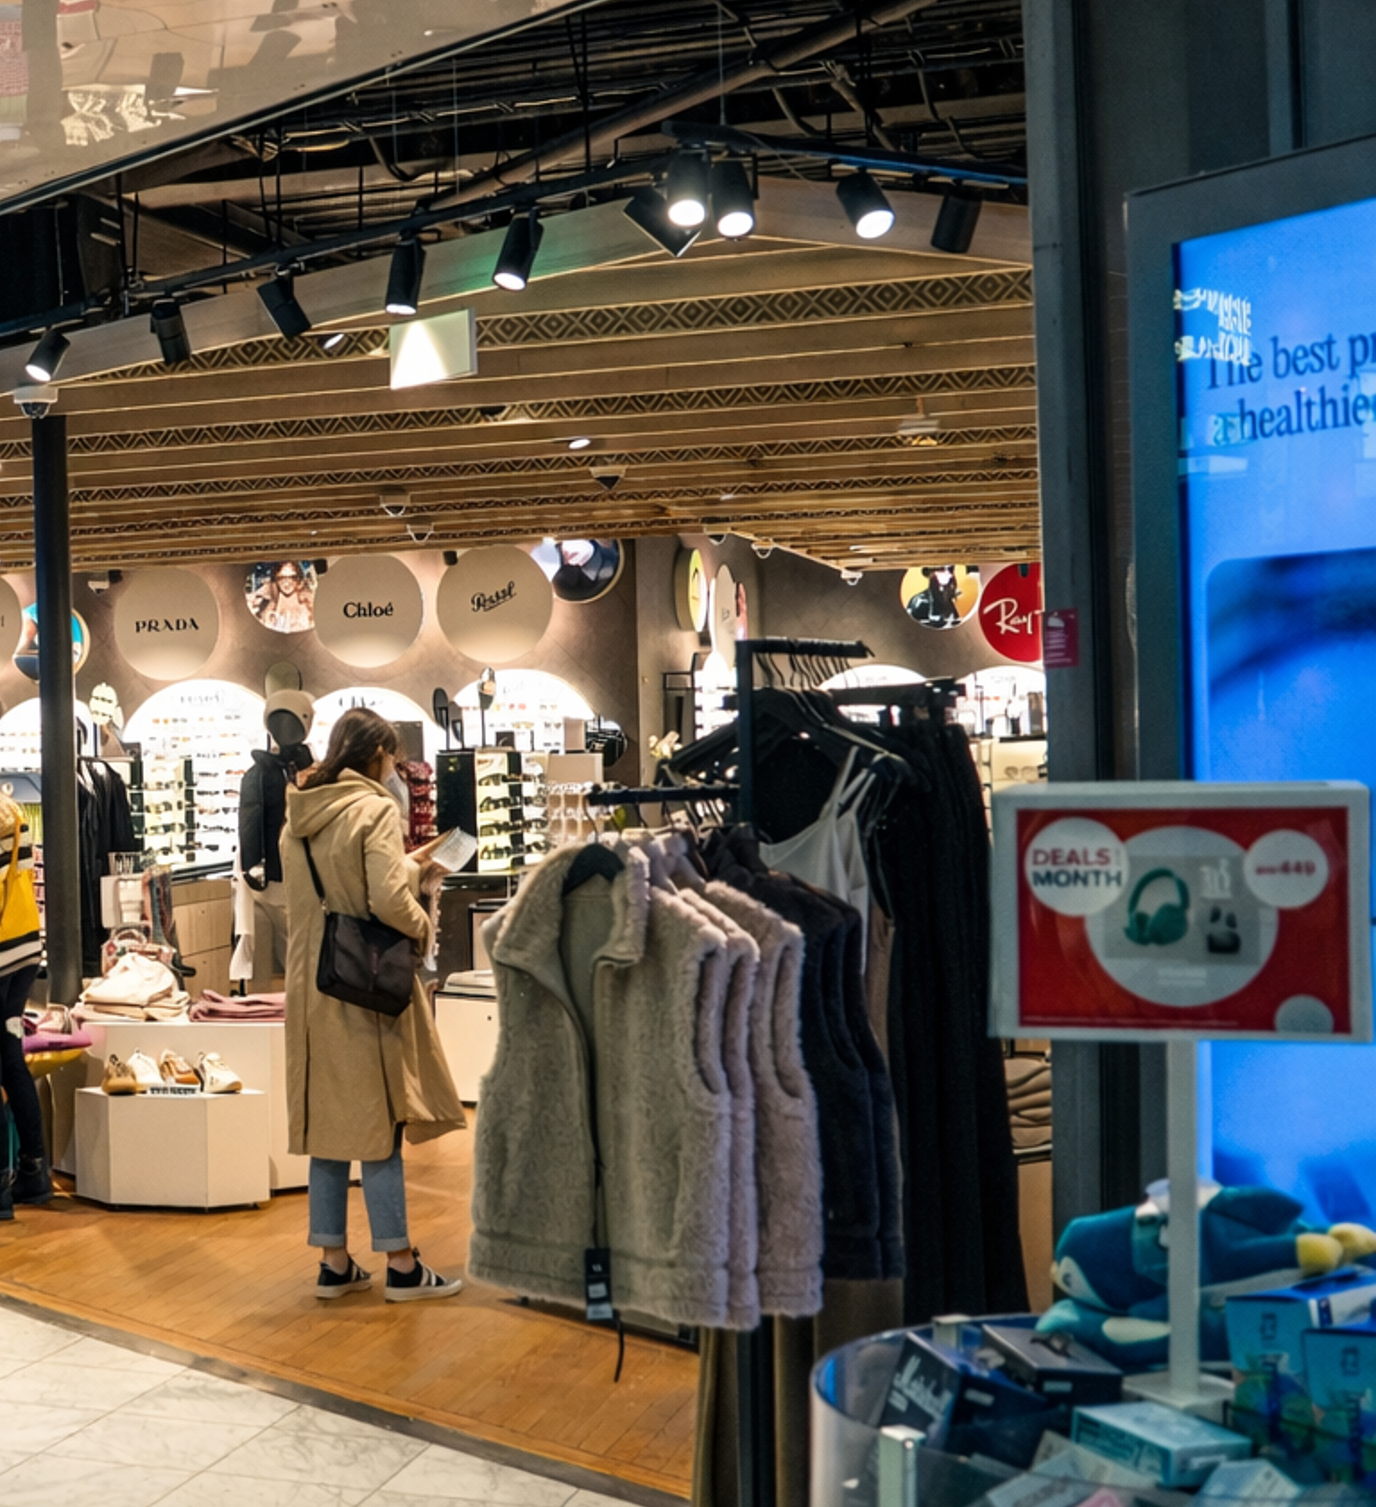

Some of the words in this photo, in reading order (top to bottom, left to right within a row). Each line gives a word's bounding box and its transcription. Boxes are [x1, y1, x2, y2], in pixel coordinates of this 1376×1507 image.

[1270, 333, 1341, 379] best
[343, 602, 394, 618] Chloé
[135, 617, 200, 633] PRADA
[1032, 847, 1112, 866] DEALS
[1032, 869, 1123, 888] MONTH
